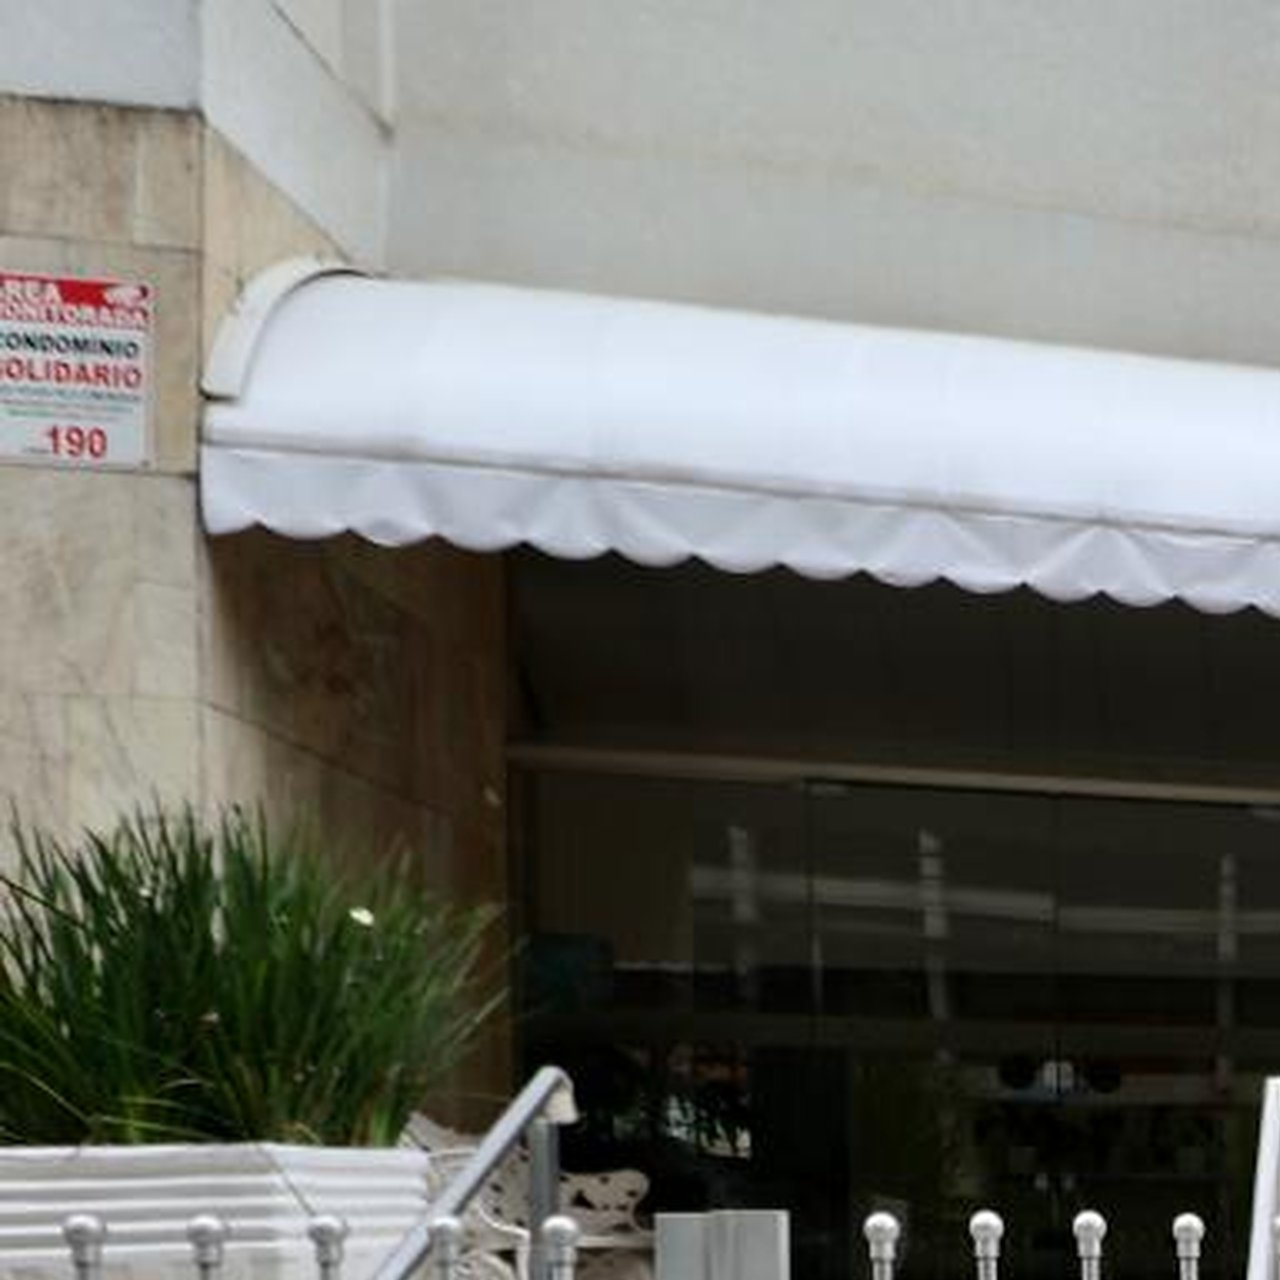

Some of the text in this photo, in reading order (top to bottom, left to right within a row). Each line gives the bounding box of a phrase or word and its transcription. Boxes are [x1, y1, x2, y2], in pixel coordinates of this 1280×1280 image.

[0, 279, 60, 305] REA
[0, 300, 148, 332] ONITORADA
[0, 331, 140, 359] ONDOMINIO
[0, 358, 142, 389] OLIDARIO
[48, 424, 107, 458] 190
